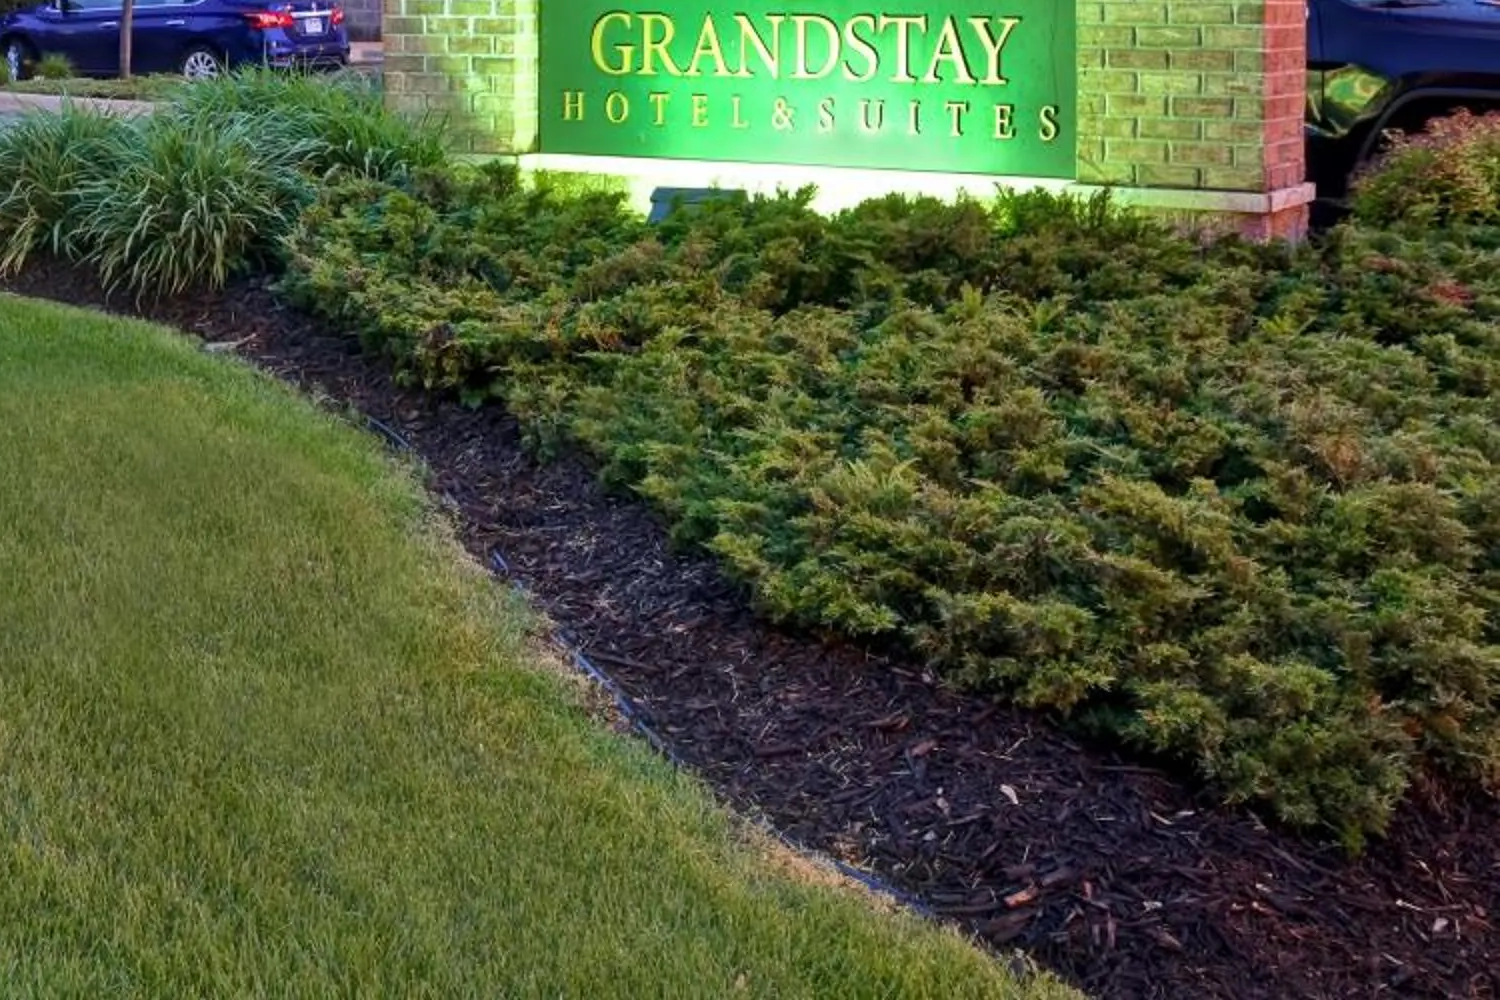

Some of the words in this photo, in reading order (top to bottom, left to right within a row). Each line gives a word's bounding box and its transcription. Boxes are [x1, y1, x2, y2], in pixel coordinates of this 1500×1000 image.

[590, 11, 1023, 86] GRANDSTAY
[563, 91, 750, 130] HOTEL
[817, 98, 1062, 142] SUITES
